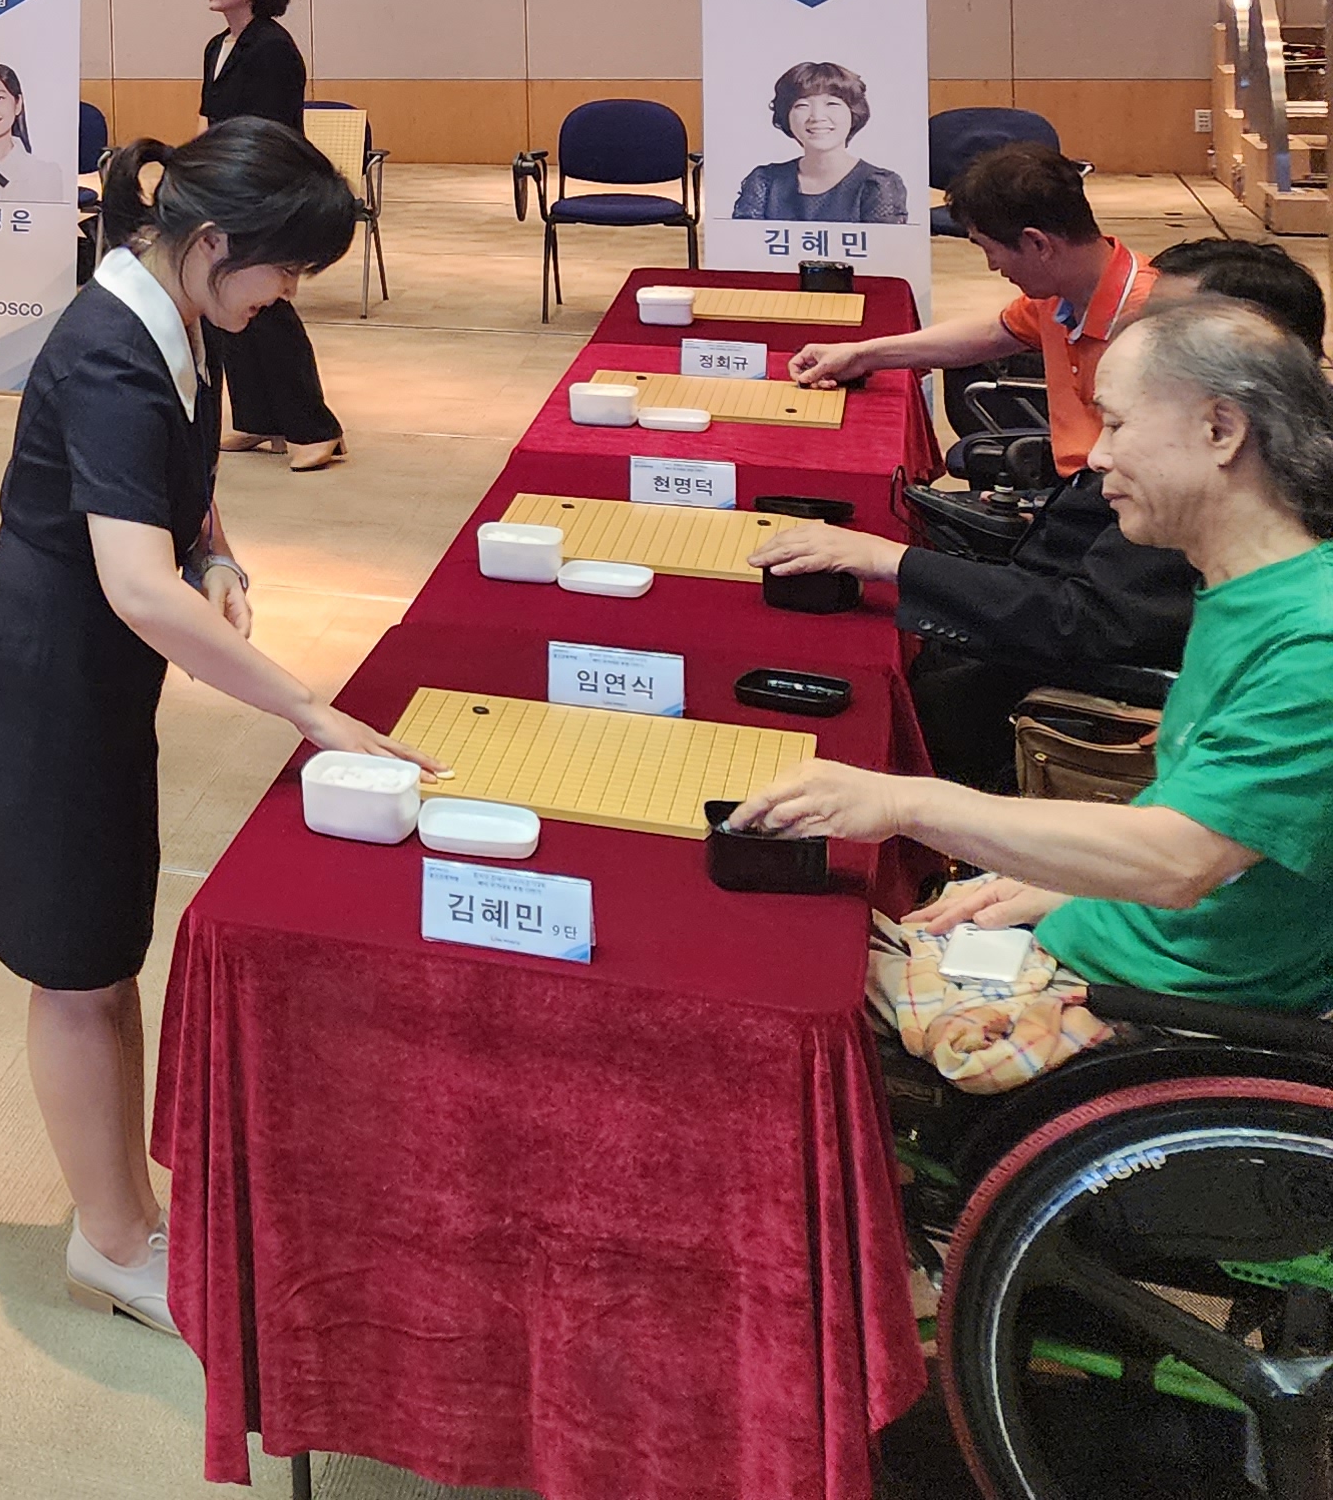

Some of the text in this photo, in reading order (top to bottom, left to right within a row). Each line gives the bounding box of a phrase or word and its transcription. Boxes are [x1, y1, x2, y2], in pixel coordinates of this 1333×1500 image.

[764, 229, 868, 259] 김혜민
[653, 475, 713, 497] 현명덕
[577, 669, 654, 700] 임연식
[448, 892, 543, 935] 김혜민
